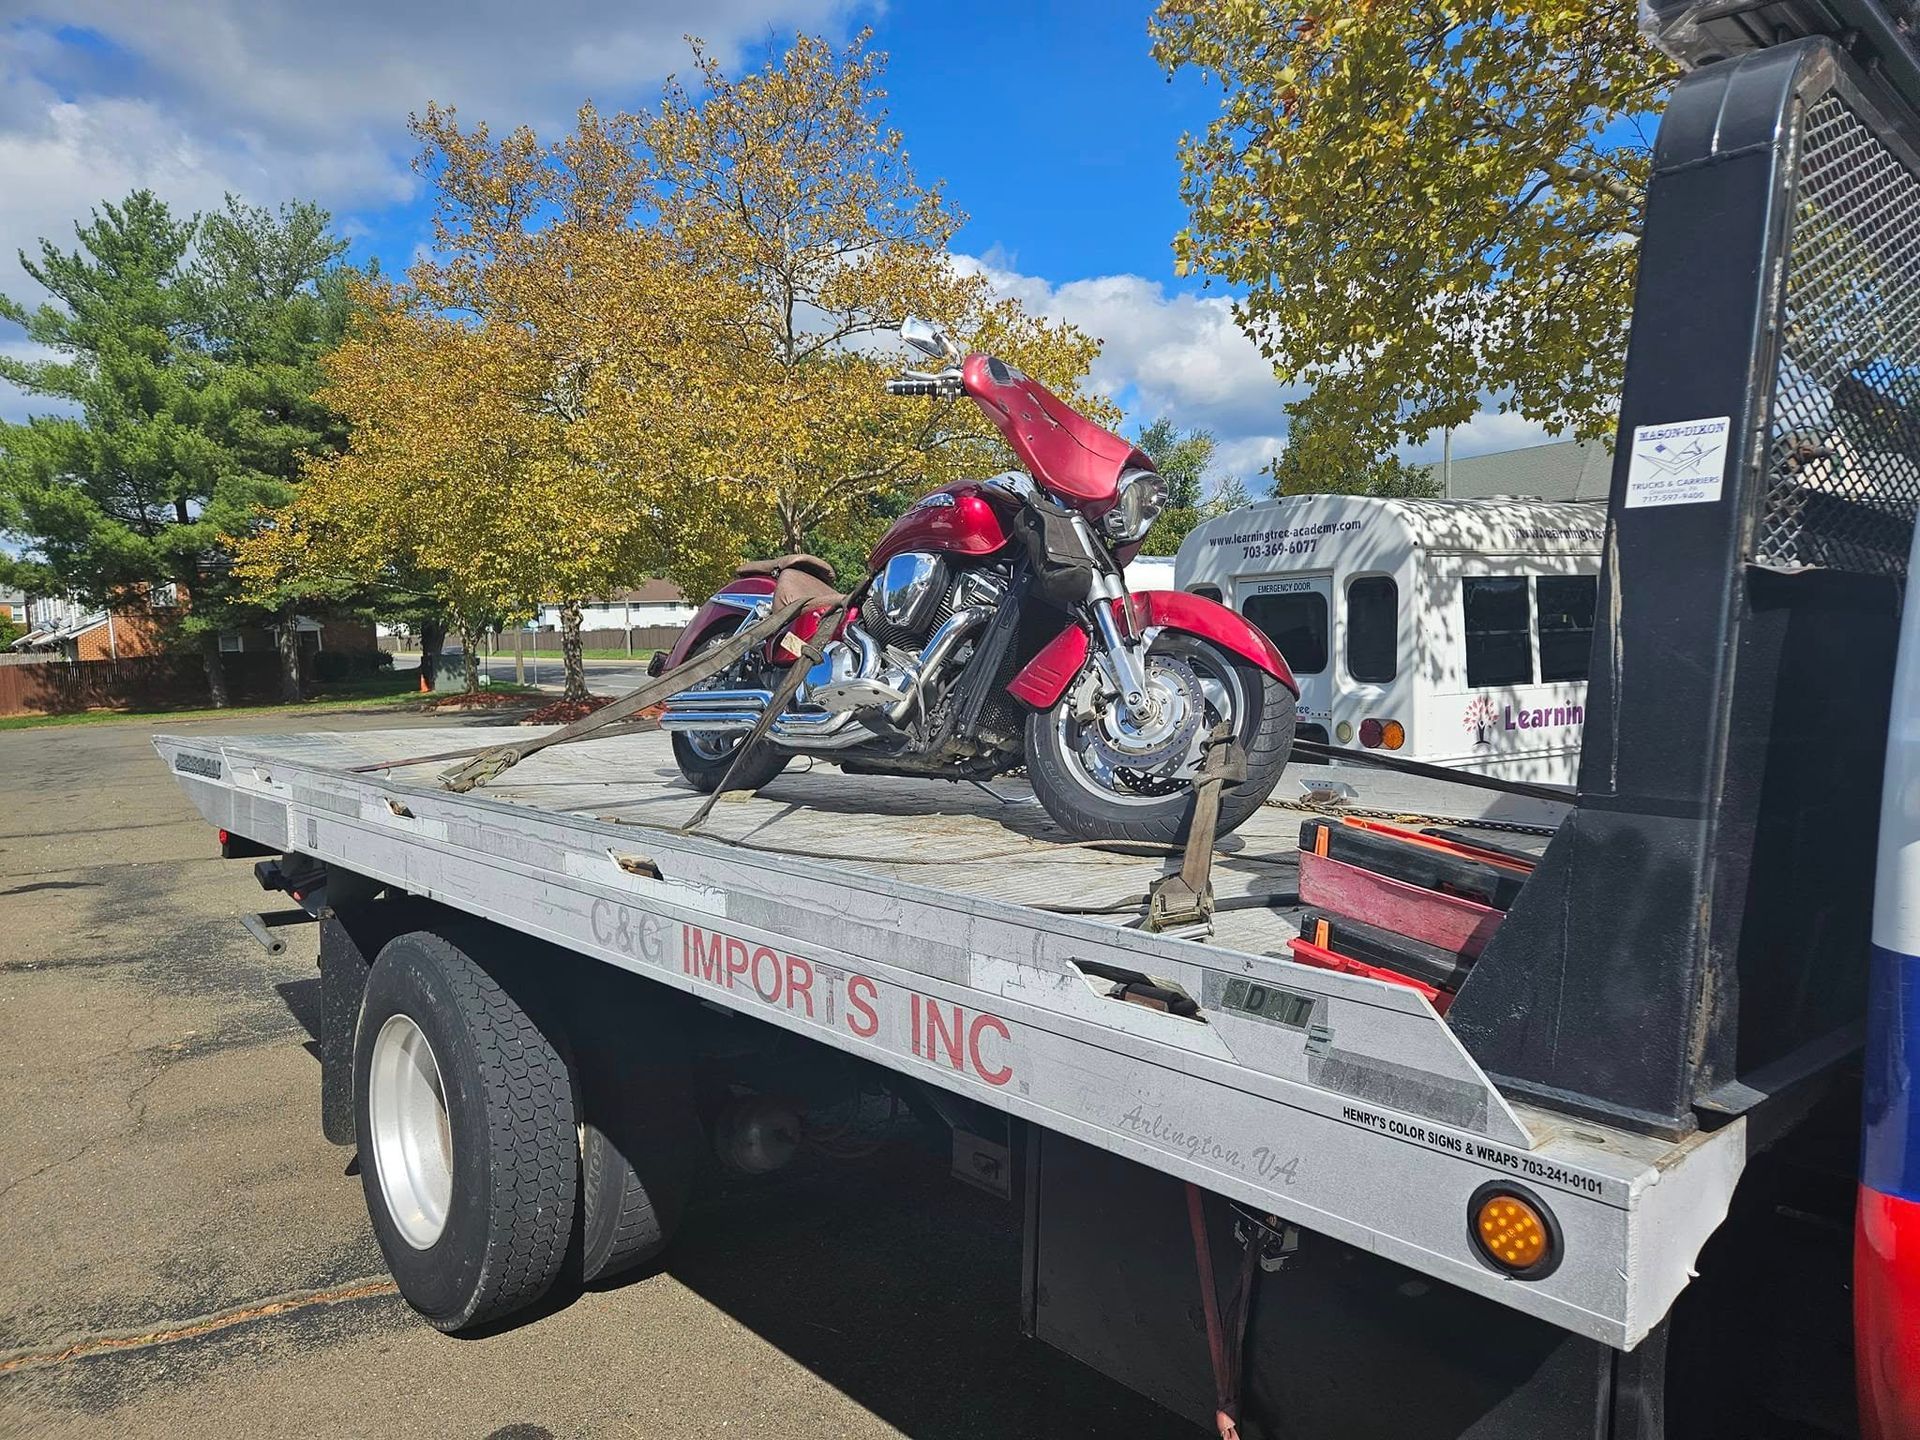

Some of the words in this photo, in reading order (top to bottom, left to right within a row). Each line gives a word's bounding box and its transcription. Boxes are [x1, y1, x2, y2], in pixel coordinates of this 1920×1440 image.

[1639, 423, 1725, 441] MASON-DIXON
[1631, 480, 1665, 491] TRUCKS
[1667, 480, 1674, 488] &
[1677, 475, 1720, 487] CARRIERS
[1209, 519, 1361, 547] www.learningtree-academy.com
[1508, 527, 1606, 541] www.learningtree
[1243, 538, 1318, 559] 703-369-6077
[1257, 582, 1292, 594] EMERGENCY
[1294, 581, 1311, 592] DOOR
[1295, 705, 1310, 714] ree
[1504, 699, 1584, 731] Learnin
[590, 898, 664, 963] C&G
[682, 924, 880, 1038] IMPORTS
[1343, 1106, 1387, 1130] HENRY'S
[1389, 1120, 1425, 1142] COLOR
[1428, 1131, 1462, 1153] SIGNS
[1465, 1142, 1474, 1156] &
[1476, 1146, 1519, 1169] WRAPS
[1522, 1159, 1603, 1195] 703-241-0101
[1252, 1145, 1299, 1186] VA
